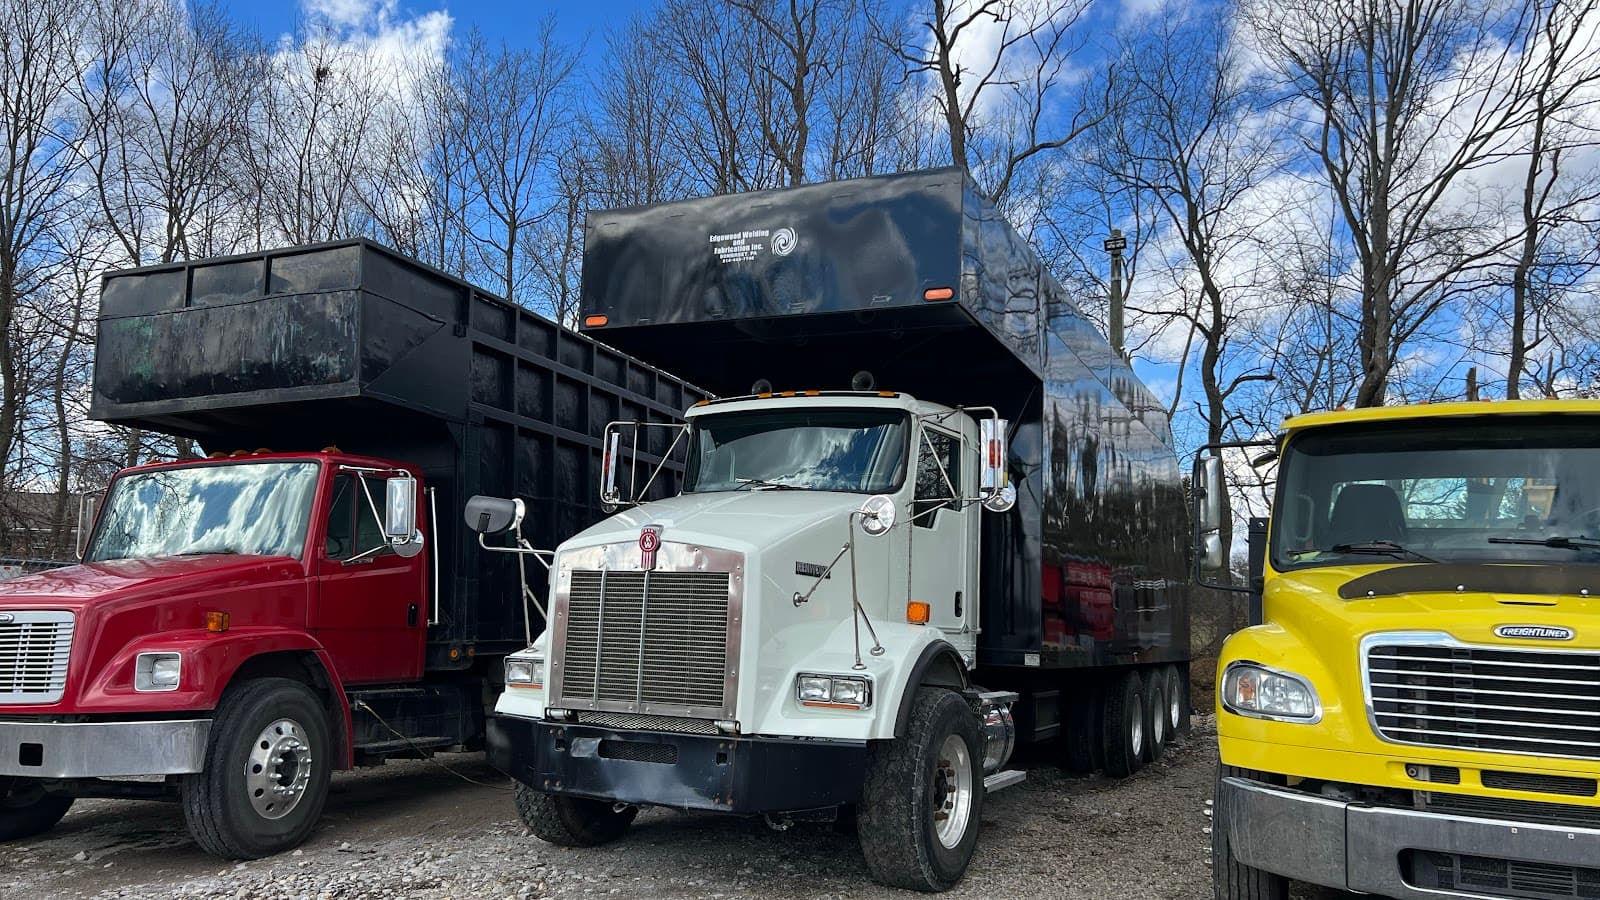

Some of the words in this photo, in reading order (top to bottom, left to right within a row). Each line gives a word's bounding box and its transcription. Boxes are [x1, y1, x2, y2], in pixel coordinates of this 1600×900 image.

[709, 232, 741, 243] Edgewood
[742, 229, 770, 239] Welding
[714, 245, 750, 255] Fabrication
[751, 243, 764, 251] Inc.
[1502, 627, 1568, 638] FREIGHTLINER
